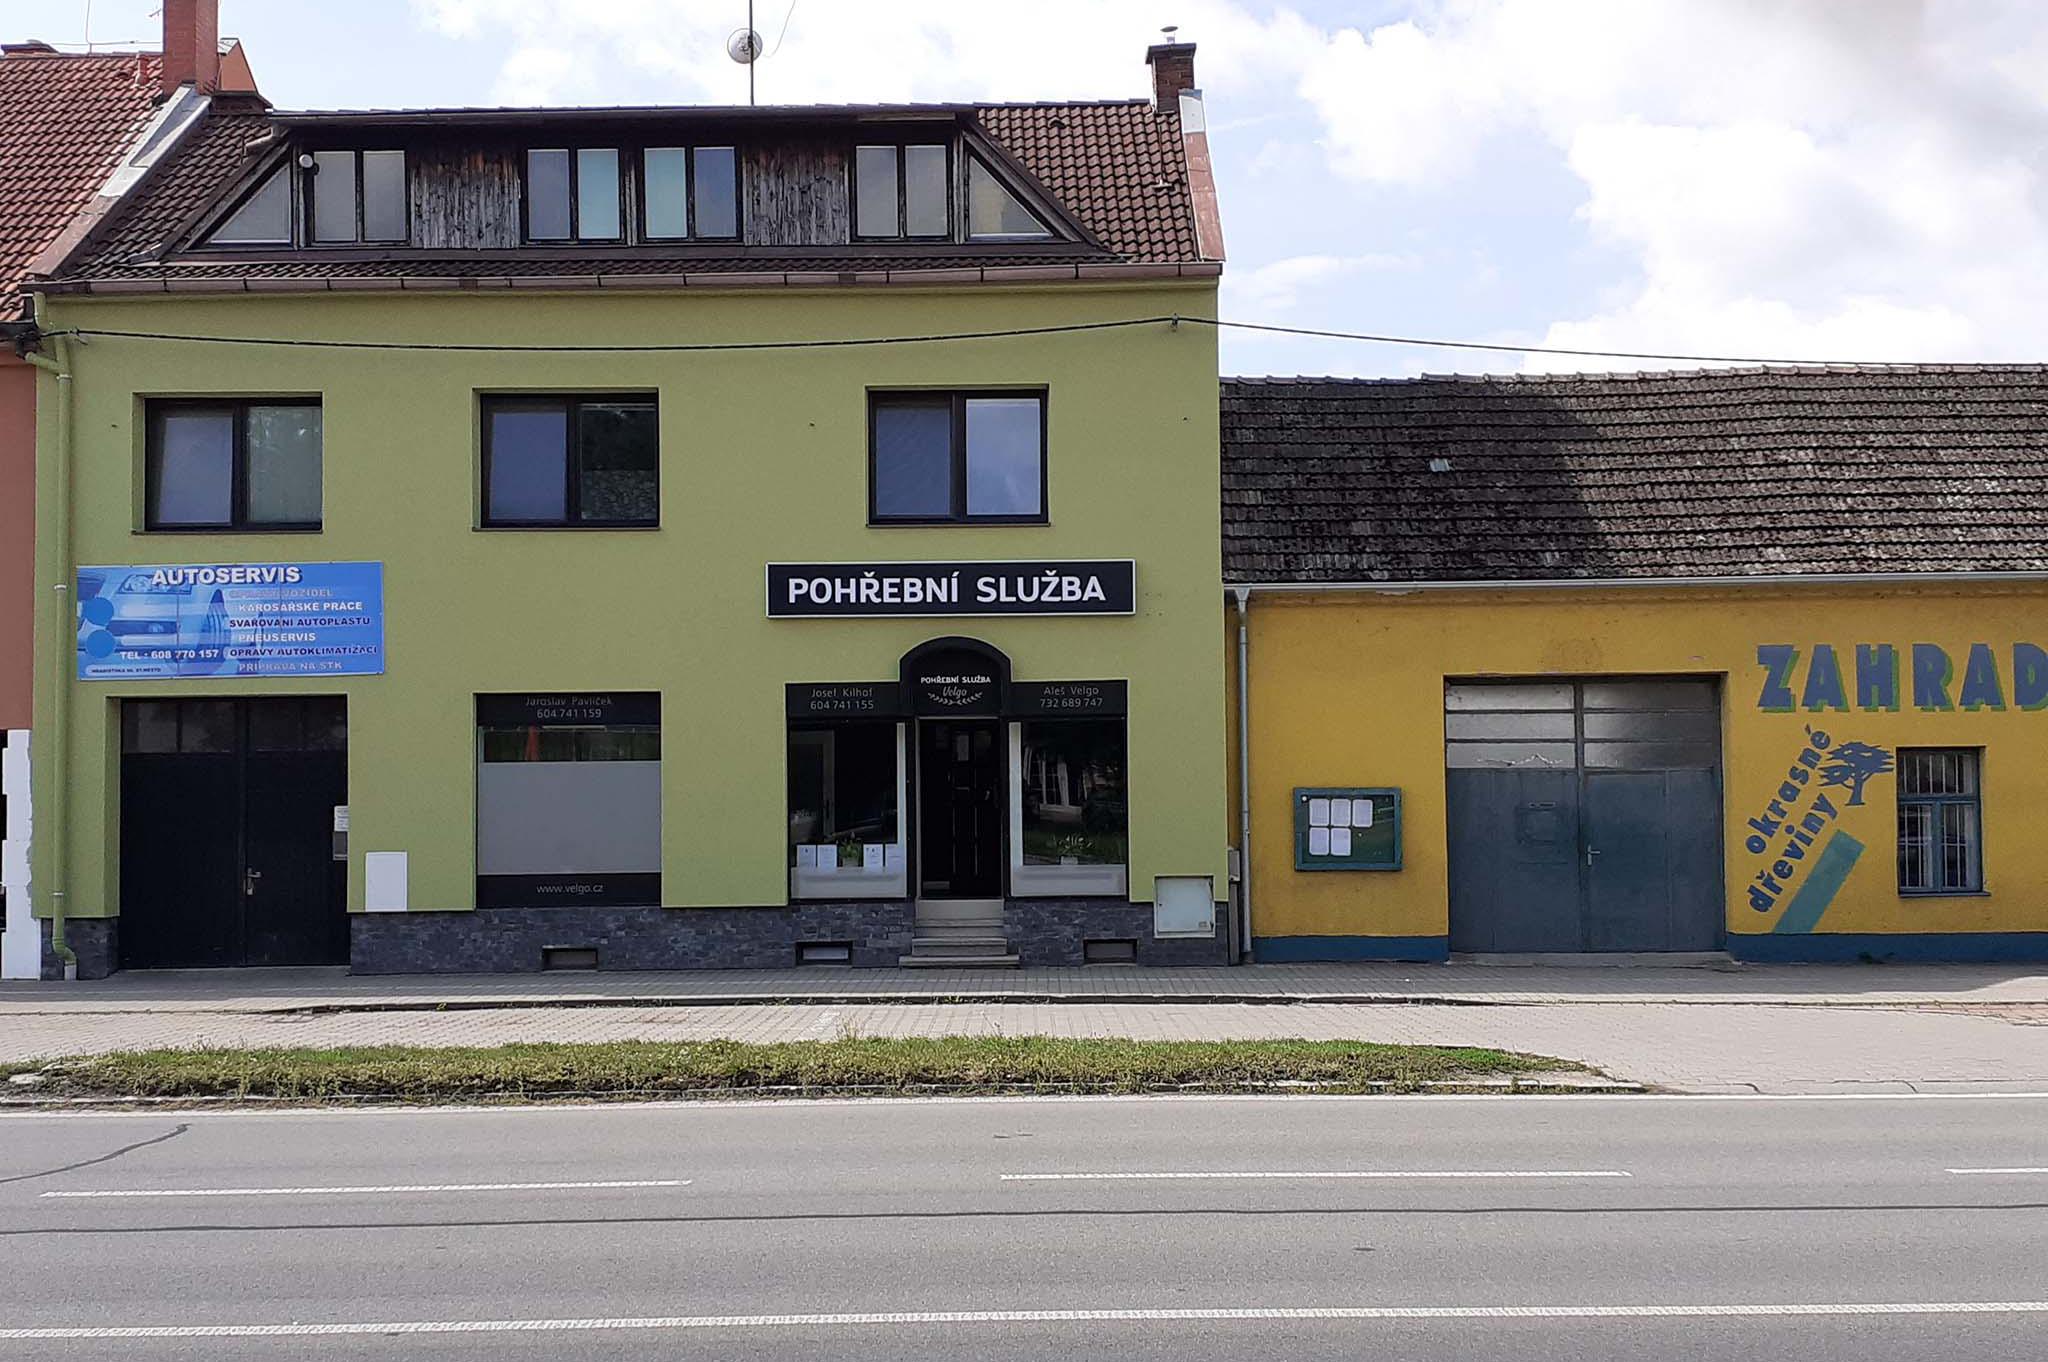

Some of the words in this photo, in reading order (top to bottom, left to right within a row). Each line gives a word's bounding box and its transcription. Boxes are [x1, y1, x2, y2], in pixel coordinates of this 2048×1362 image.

[151, 566, 303, 586] AUTOSERVIS
[788, 571, 960, 604] POHŘEBNÍ
[976, 570, 1106, 603] SLUŽBA
[239, 632, 317, 643] PNEUSERVIS
[151, 650, 172, 659] 608
[175, 650, 196, 659] 770
[198, 649, 219, 659] 157
[229, 648, 274, 658] OPRAVY
[300, 662, 316, 671] NA
[318, 660, 343, 670] STK
[920, 674, 959, 684] POHŘEBNÍ
[962, 674, 991, 684] SLUŽBA
[1757, 642, 2048, 713] ZAHRAD
[811, 687, 837, 698] Josef
[942, 686, 967, 699] Velgo
[1070, 685, 1100, 697] Velgo
[526, 695, 567, 706] Jaroslav
[810, 700, 830, 710] 604
[832, 700, 851, 710] 741
[855, 700, 874, 710] 155
[1040, 698, 1059, 708] 732
[1061, 698, 1082, 708] 689
[1083, 697, 1103, 708] 747
[536, 708, 557, 718] 604
[560, 708, 578, 718] 741
[583, 708, 602, 718] 159
[1745, 723, 1831, 854] okrasné
[1747, 793, 1839, 913] dřeviny
[536, 883, 604, 895] www.velgo.cz
